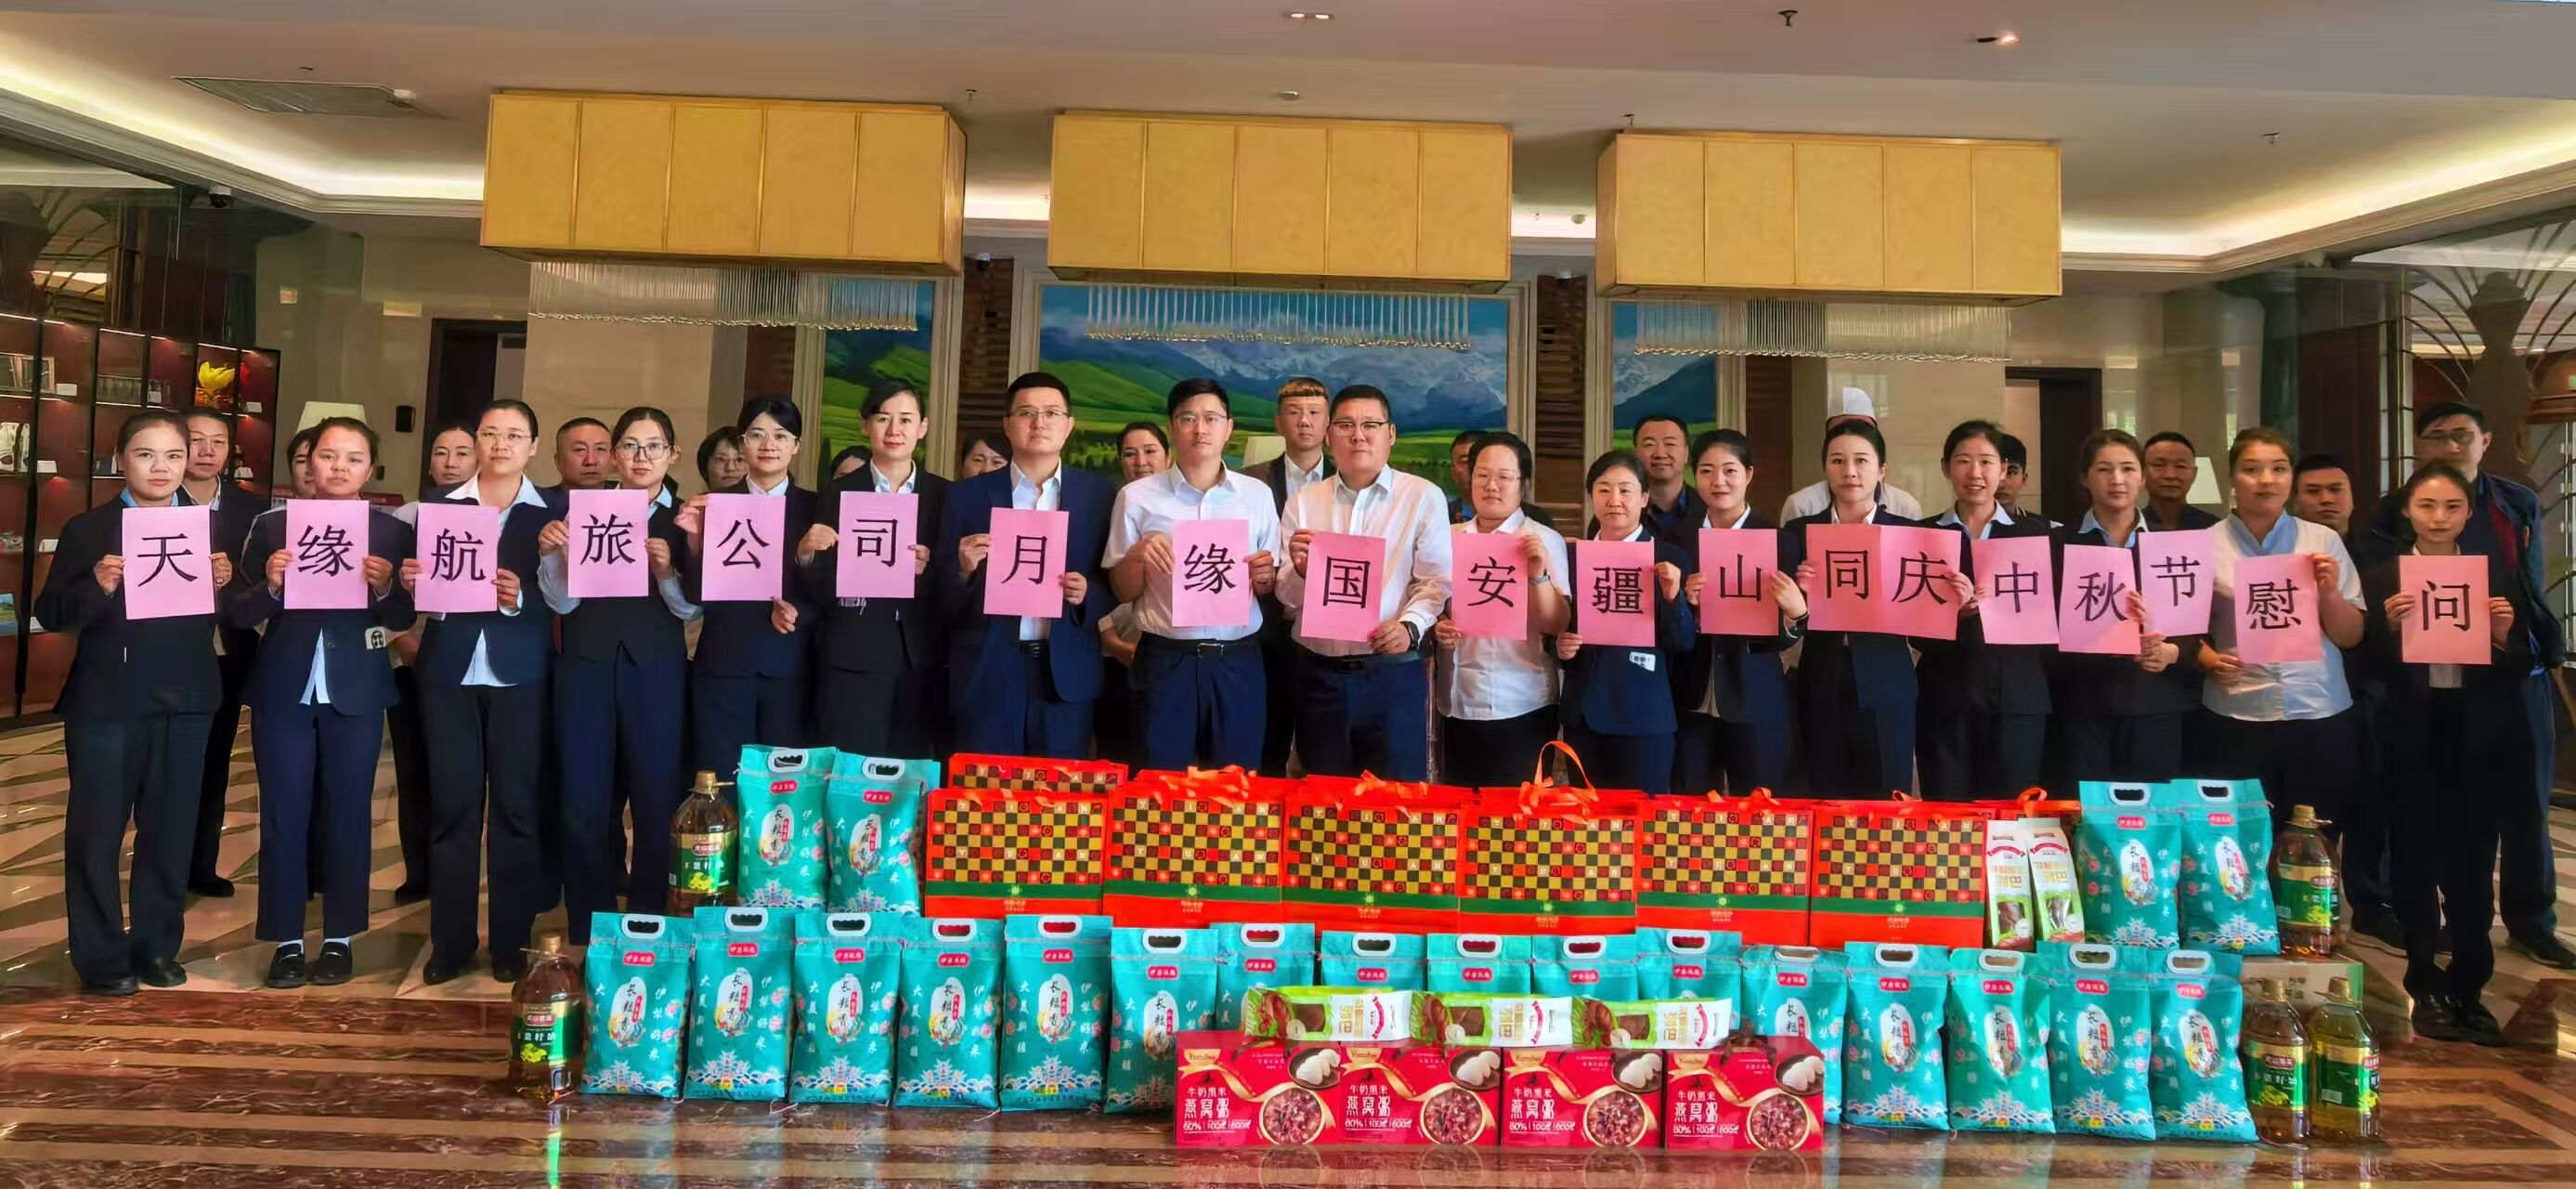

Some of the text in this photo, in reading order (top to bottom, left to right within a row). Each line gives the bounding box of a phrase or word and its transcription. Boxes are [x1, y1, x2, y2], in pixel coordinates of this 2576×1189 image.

[137, 533, 198, 587] 天
[297, 525, 355, 577] 缘
[430, 528, 487, 581] 航
[579, 514, 636, 566] 旅
[717, 518, 770, 569] 公
[852, 518, 898, 568] 司
[1002, 534, 1047, 585] 月
[1183, 542, 1236, 594] 缘
[1322, 555, 1371, 609] 国
[1467, 556, 1516, 608] 安
[1592, 567, 1644, 615] 疆
[1719, 554, 1763, 603] 山
[1825, 549, 1869, 600] 同
[1893, 552, 1948, 605] 庆
[1995, 564, 2038, 613] 中
[2151, 555, 2200, 601] 节
[2078, 573, 2127, 621] 秋
[2248, 579, 2301, 630] 慰
[2422, 581, 2470, 632] 问
[1184, 1098, 1229, 1119] 燕窝粥
[1346, 1096, 1390, 1117] 燕窝粥
[1510, 1099, 1555, 1119] 燕窝粥
[1674, 1102, 1718, 1123] 燕窝粥
